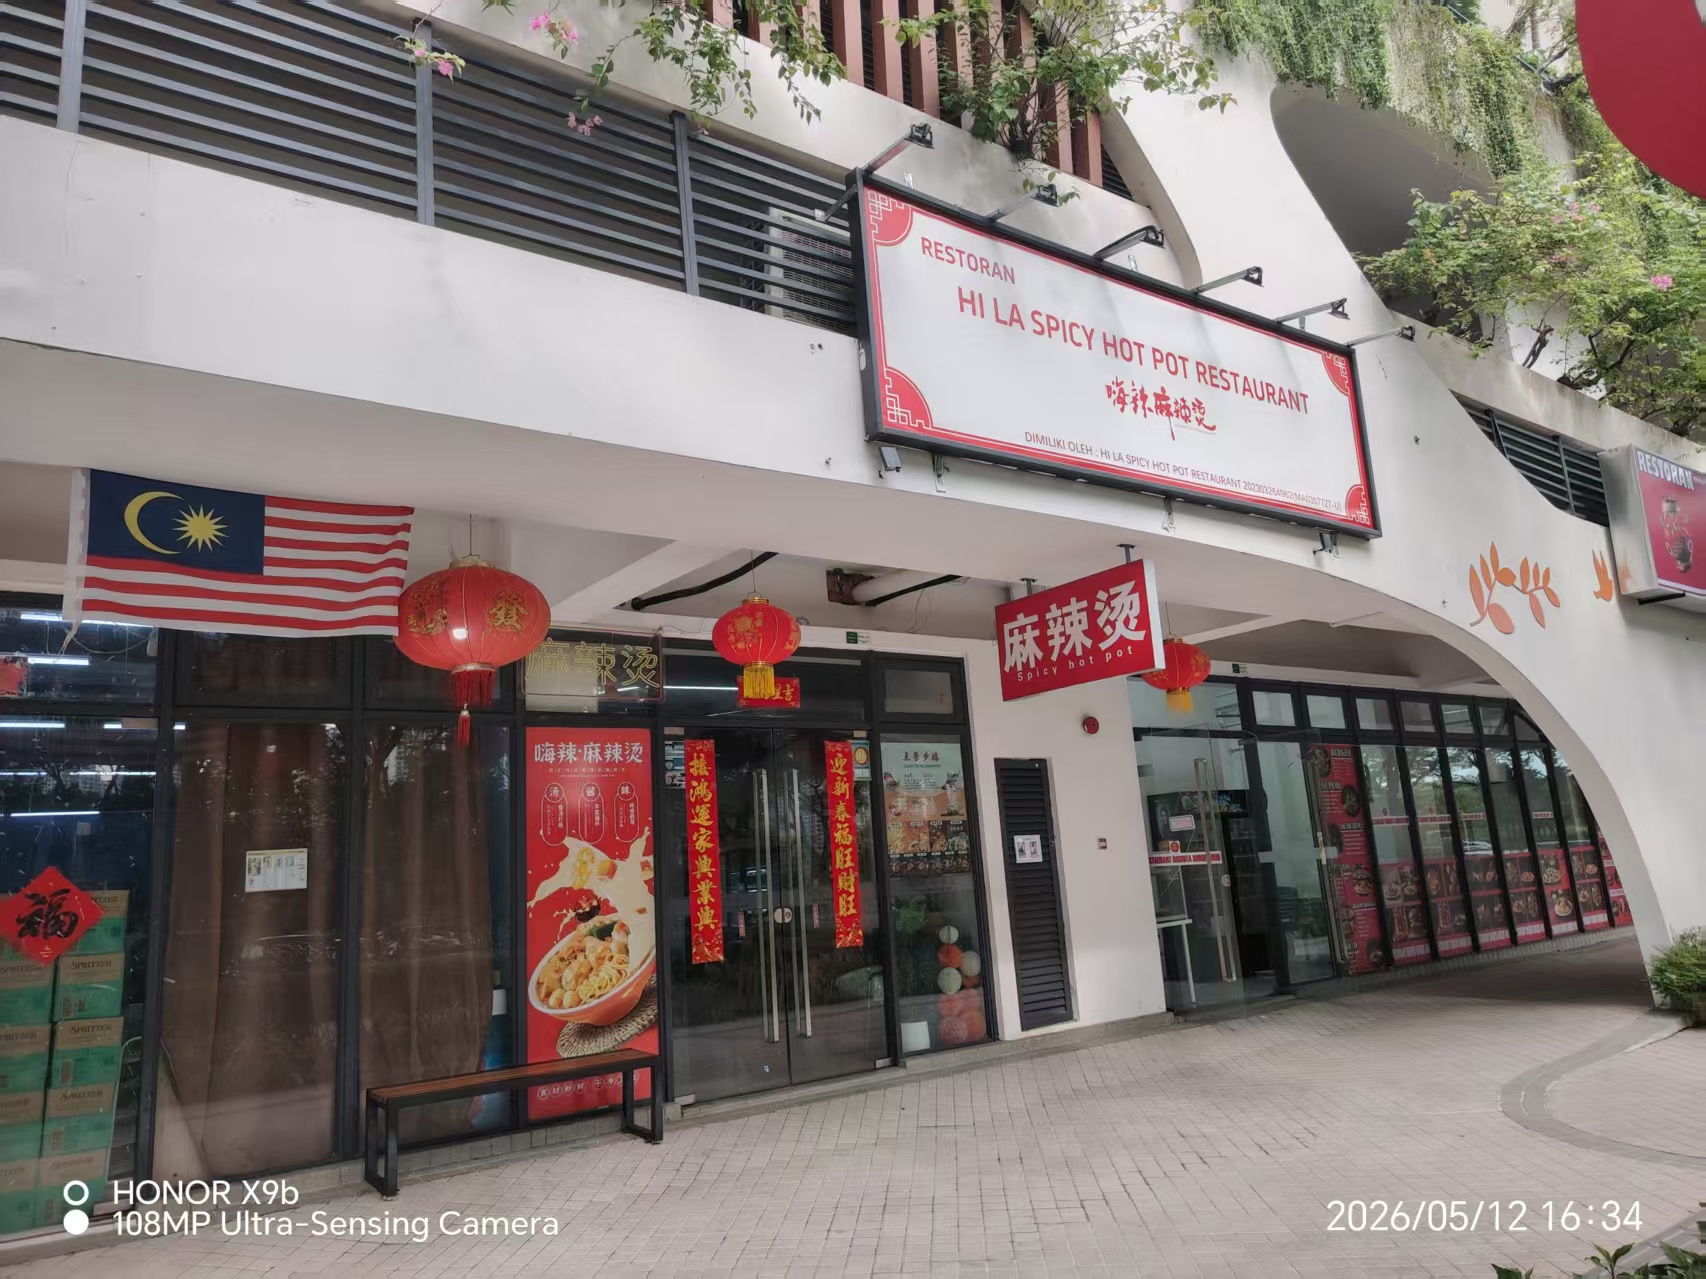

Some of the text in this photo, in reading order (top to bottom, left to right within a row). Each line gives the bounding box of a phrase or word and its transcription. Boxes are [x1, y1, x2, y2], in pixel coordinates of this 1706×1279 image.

[921, 237, 1015, 284] RESTORAN
[958, 286, 1309, 414] HI LA SPICY HOT POT RESTAURANT
[1024, 431, 1066, 450] DIMILIKI
[1068, 441, 1093, 456] OLEH
[1100, 448, 1111, 460] HI
[1112, 450, 1125, 463] LA
[1126, 454, 1150, 469] SPICY
[1152, 459, 1171, 473] HOT
[1173, 465, 1189, 476] POT
[1191, 468, 1241, 489] RESTAURANT
[1637, 450, 1694, 491] RESTORAN
[1003, 580, 1147, 673] 麻辣烫
[527, 637, 660, 688] 麻辣烫
[1017, 645, 1133, 682] Spicy hot pot
[16, 889, 78, 940] 福
